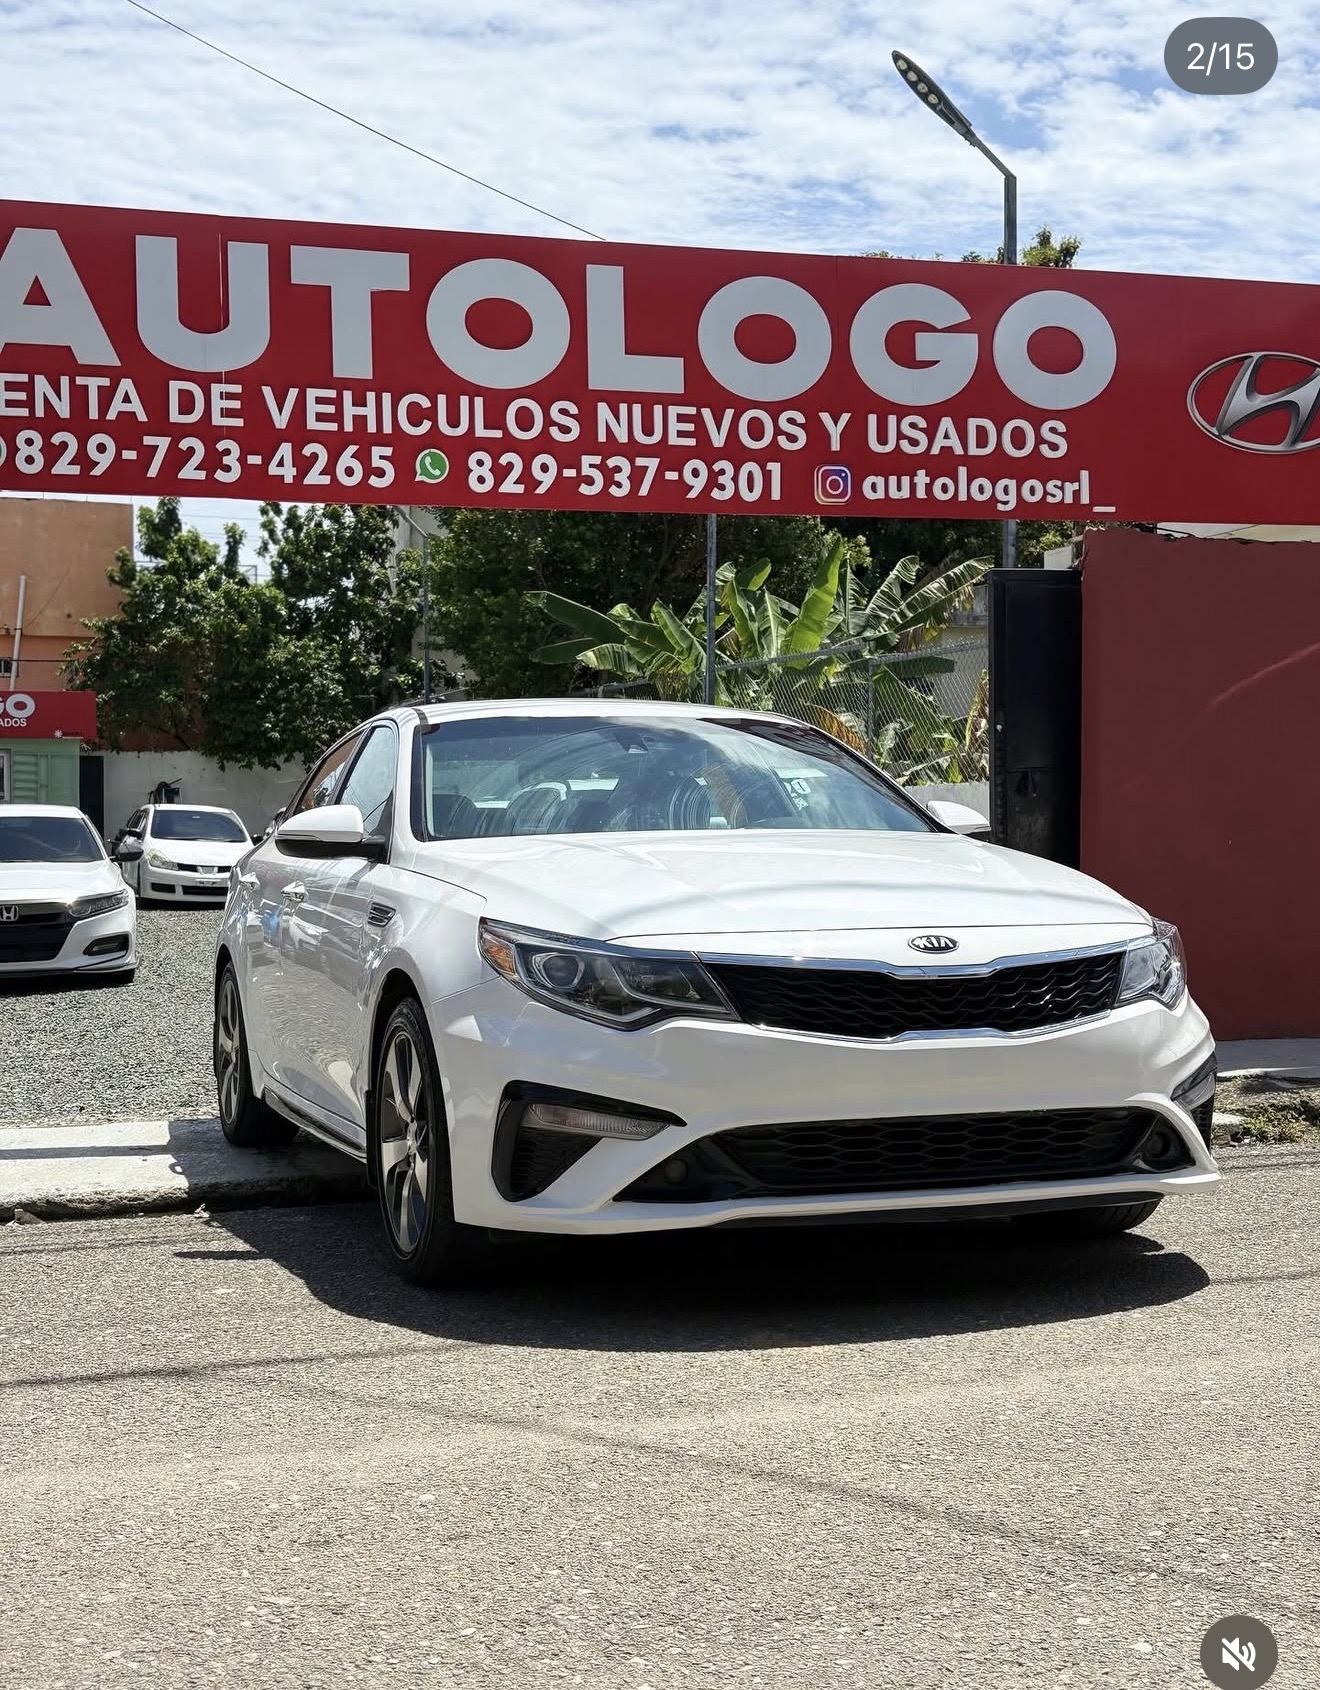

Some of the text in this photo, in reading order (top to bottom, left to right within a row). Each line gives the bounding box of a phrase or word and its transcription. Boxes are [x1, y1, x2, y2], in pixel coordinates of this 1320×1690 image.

[0, 228, 1117, 411] AUTOLOGO
[169, 381, 244, 427] DE
[262, 386, 581, 443] VEHICULOS
[598, 402, 807, 451] NUEVOS
[819, 412, 852, 452] Y
[868, 414, 1068, 459] USADOS
[15, 430, 1116, 513] 829-723-4265 829-537-9301 autologosrl_
[0, 693, 35, 718] O
